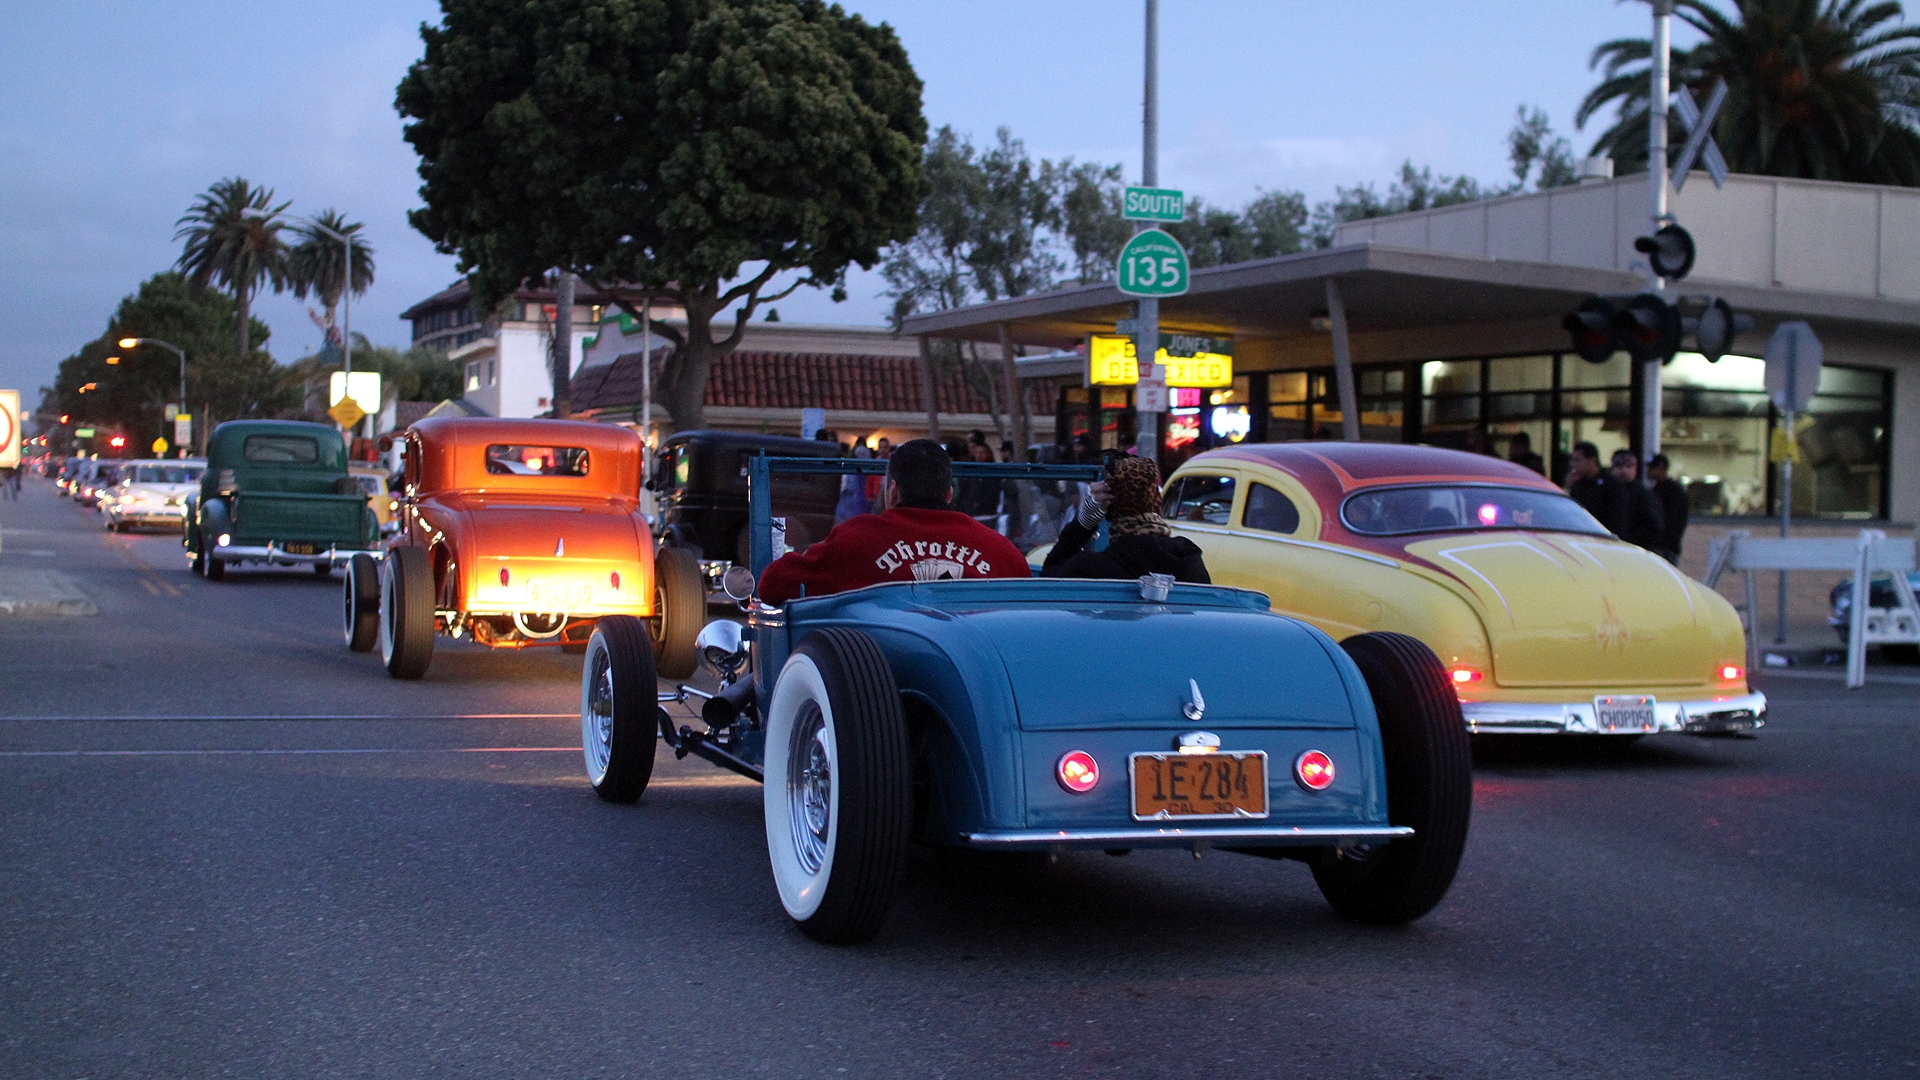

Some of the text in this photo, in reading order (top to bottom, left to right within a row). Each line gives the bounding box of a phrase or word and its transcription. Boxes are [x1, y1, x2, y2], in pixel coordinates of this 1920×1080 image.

[1127, 191, 1181, 215] SOUTH
[1127, 256, 1180, 287] 135
[1168, 335, 1211, 352] JONES
[1165, 363, 1220, 380] EXICO
[875, 540, 991, 574] Throttle
[1600, 709, 1654, 728] CHOPD50
